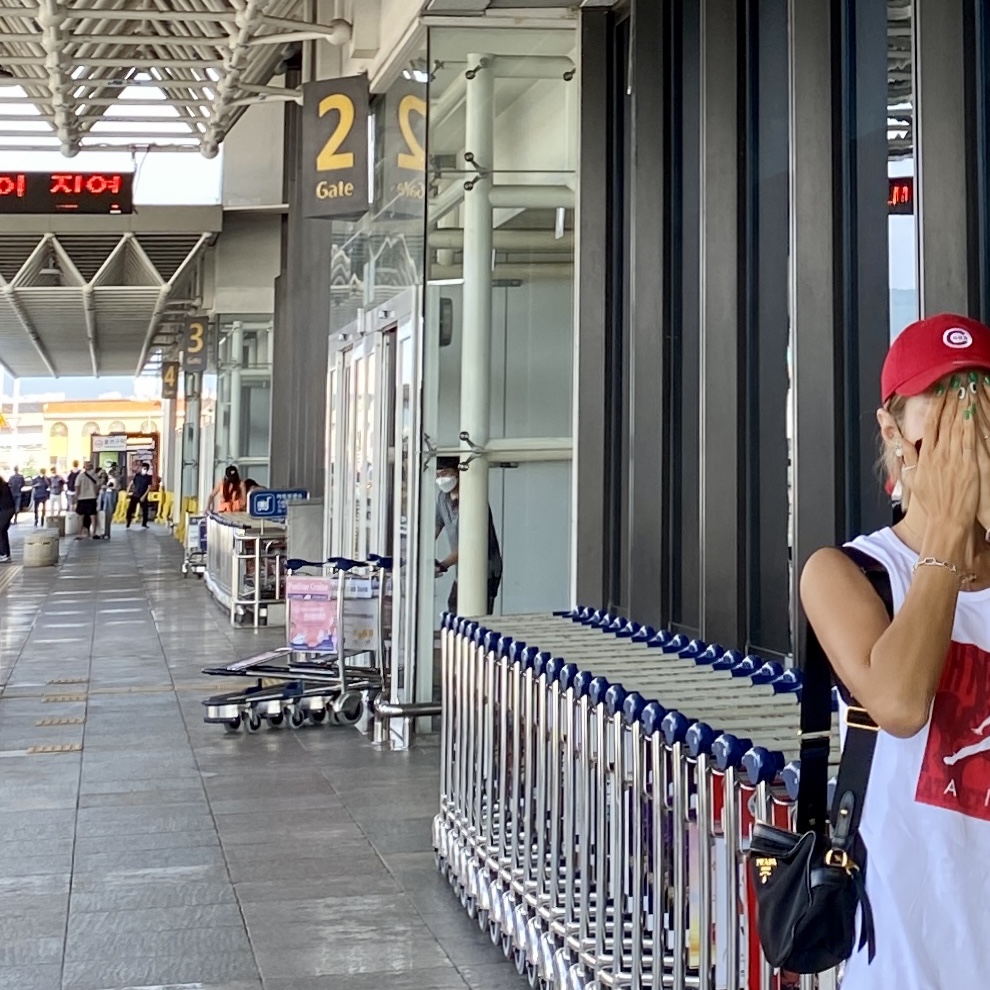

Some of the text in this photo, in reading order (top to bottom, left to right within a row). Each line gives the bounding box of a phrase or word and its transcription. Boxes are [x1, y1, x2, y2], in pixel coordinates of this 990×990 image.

[316, 94, 354, 171] 2
[315, 181, 354, 199] Gate
[187, 322, 204, 353] 3
[164, 365, 176, 387] 4
